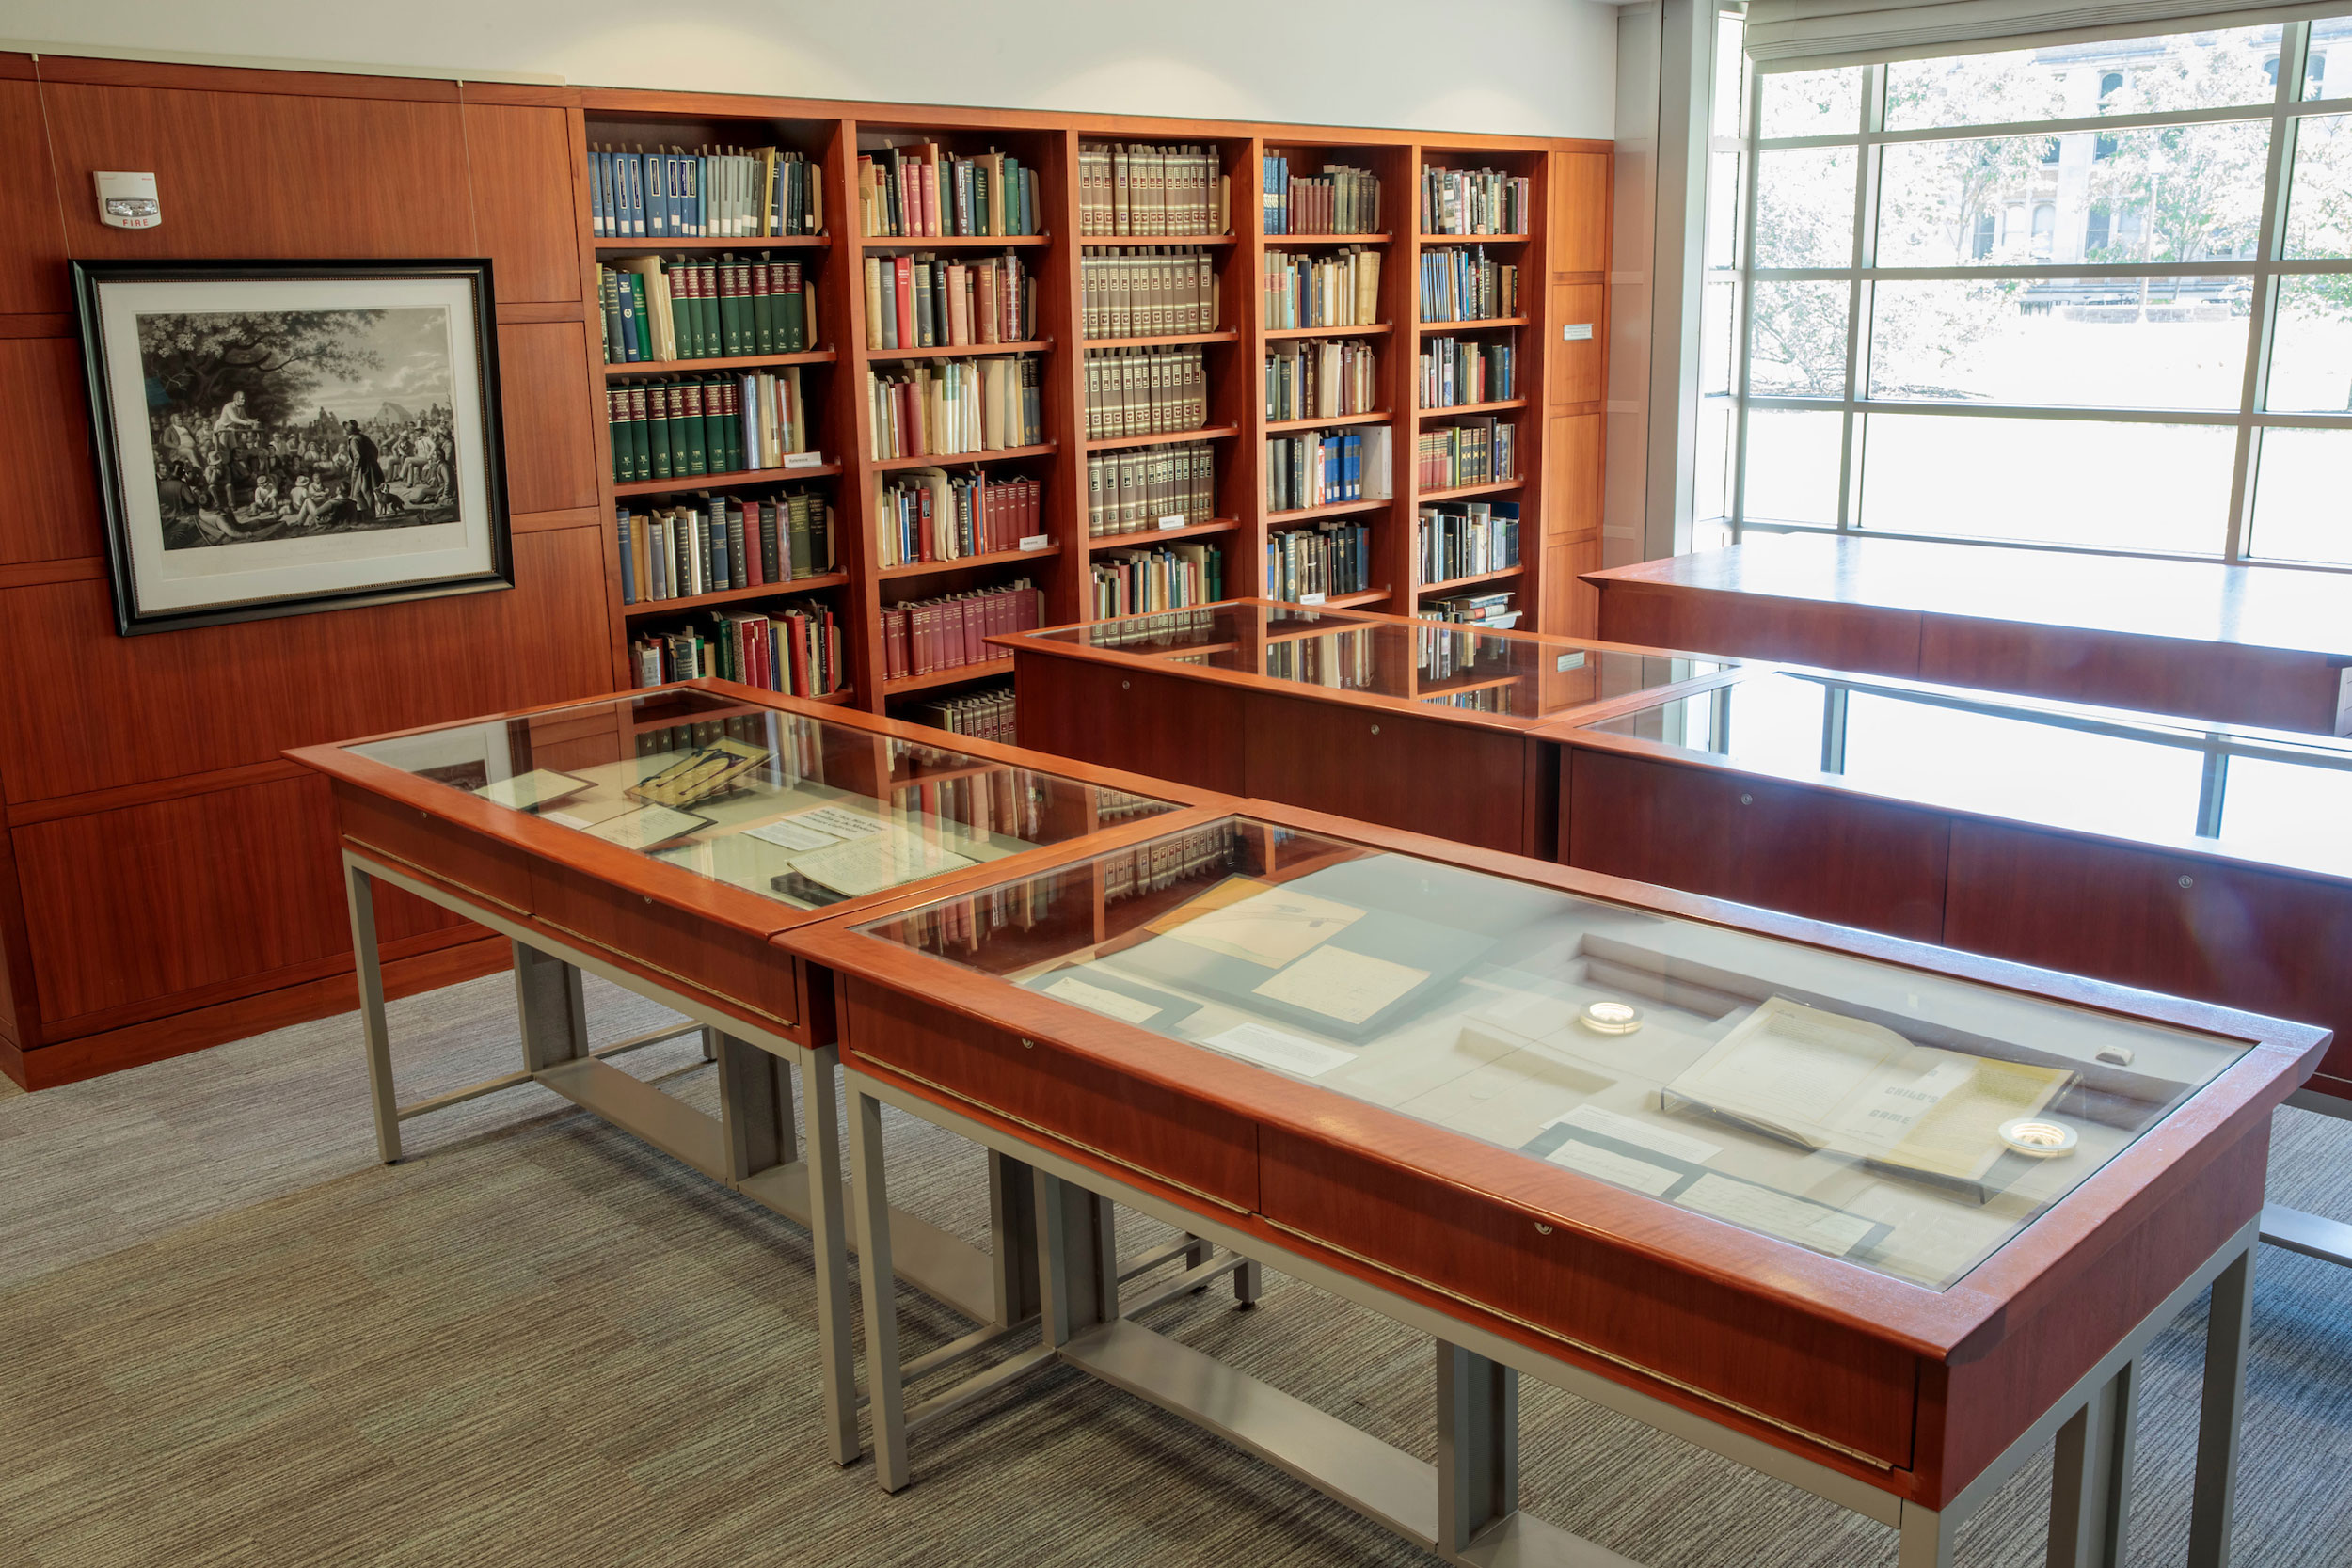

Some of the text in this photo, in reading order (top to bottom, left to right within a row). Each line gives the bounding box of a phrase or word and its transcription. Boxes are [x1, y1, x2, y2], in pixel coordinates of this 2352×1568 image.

[122, 218, 149, 227] FIRE
[1884, 1086, 1939, 1104] CHILD'S
[1867, 1109, 1913, 1125] GAME
